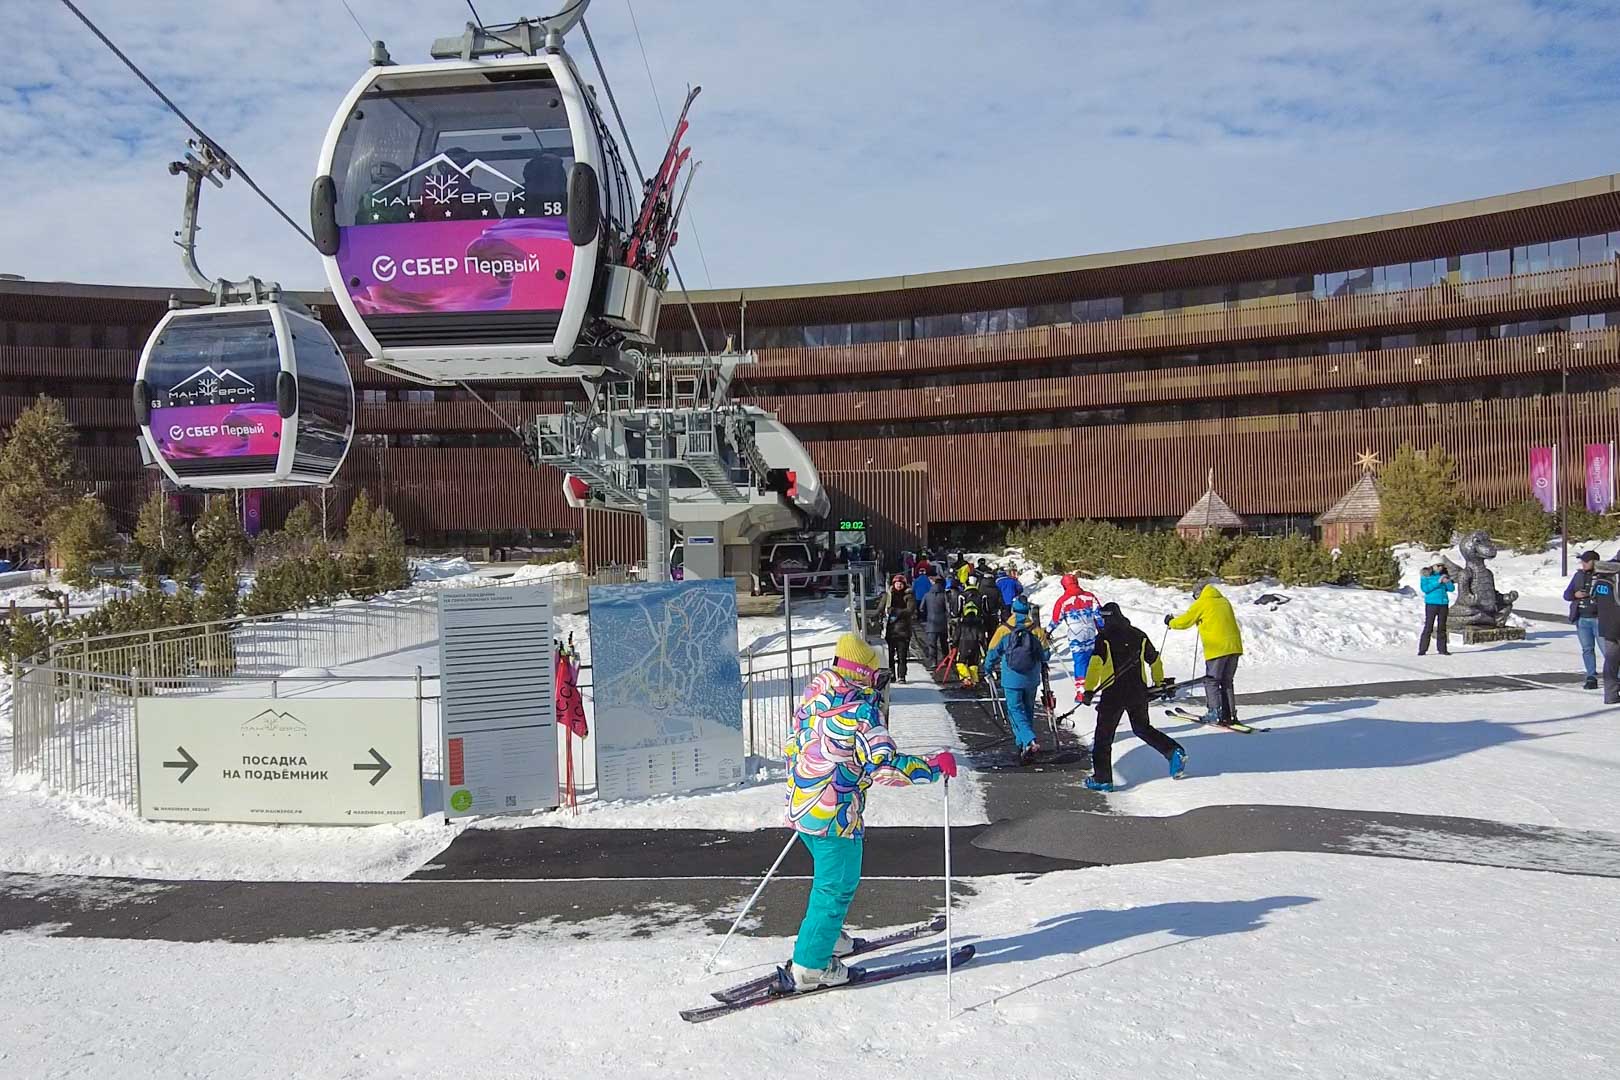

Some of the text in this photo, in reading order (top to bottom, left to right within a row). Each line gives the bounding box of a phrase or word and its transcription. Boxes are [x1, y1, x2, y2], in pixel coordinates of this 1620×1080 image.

[543, 202, 563, 216] 58
[401, 254, 541, 277] СБЕР Первый
[186, 423, 265, 438] СБЕР Первый
[242, 756, 308, 767] ПОСАДКА
[223, 767, 329, 782] НА ПОДЪЁМНИК
